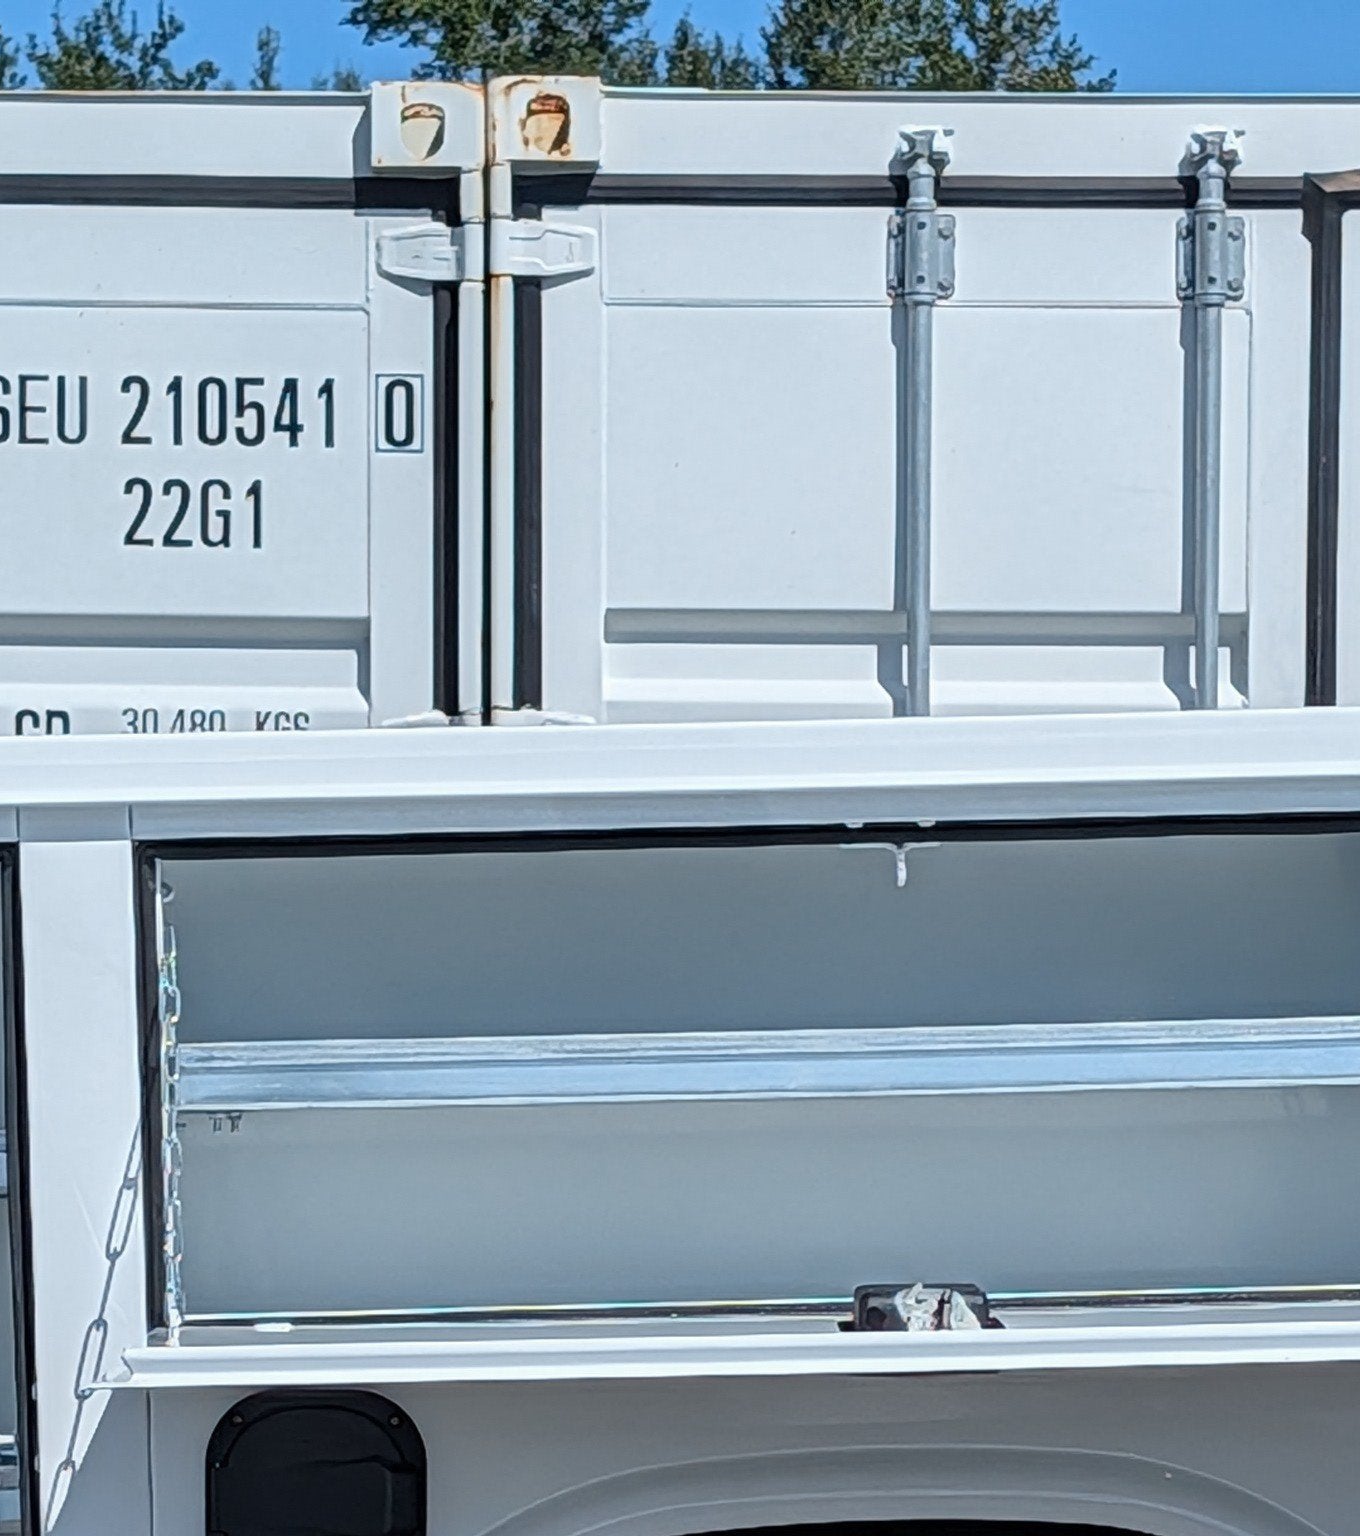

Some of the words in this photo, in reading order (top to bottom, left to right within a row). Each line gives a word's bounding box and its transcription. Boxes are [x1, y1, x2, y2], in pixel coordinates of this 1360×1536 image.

[120, 375, 336, 448] 210541
[383, 378, 416, 448] 0
[122, 477, 264, 550] 22G1
